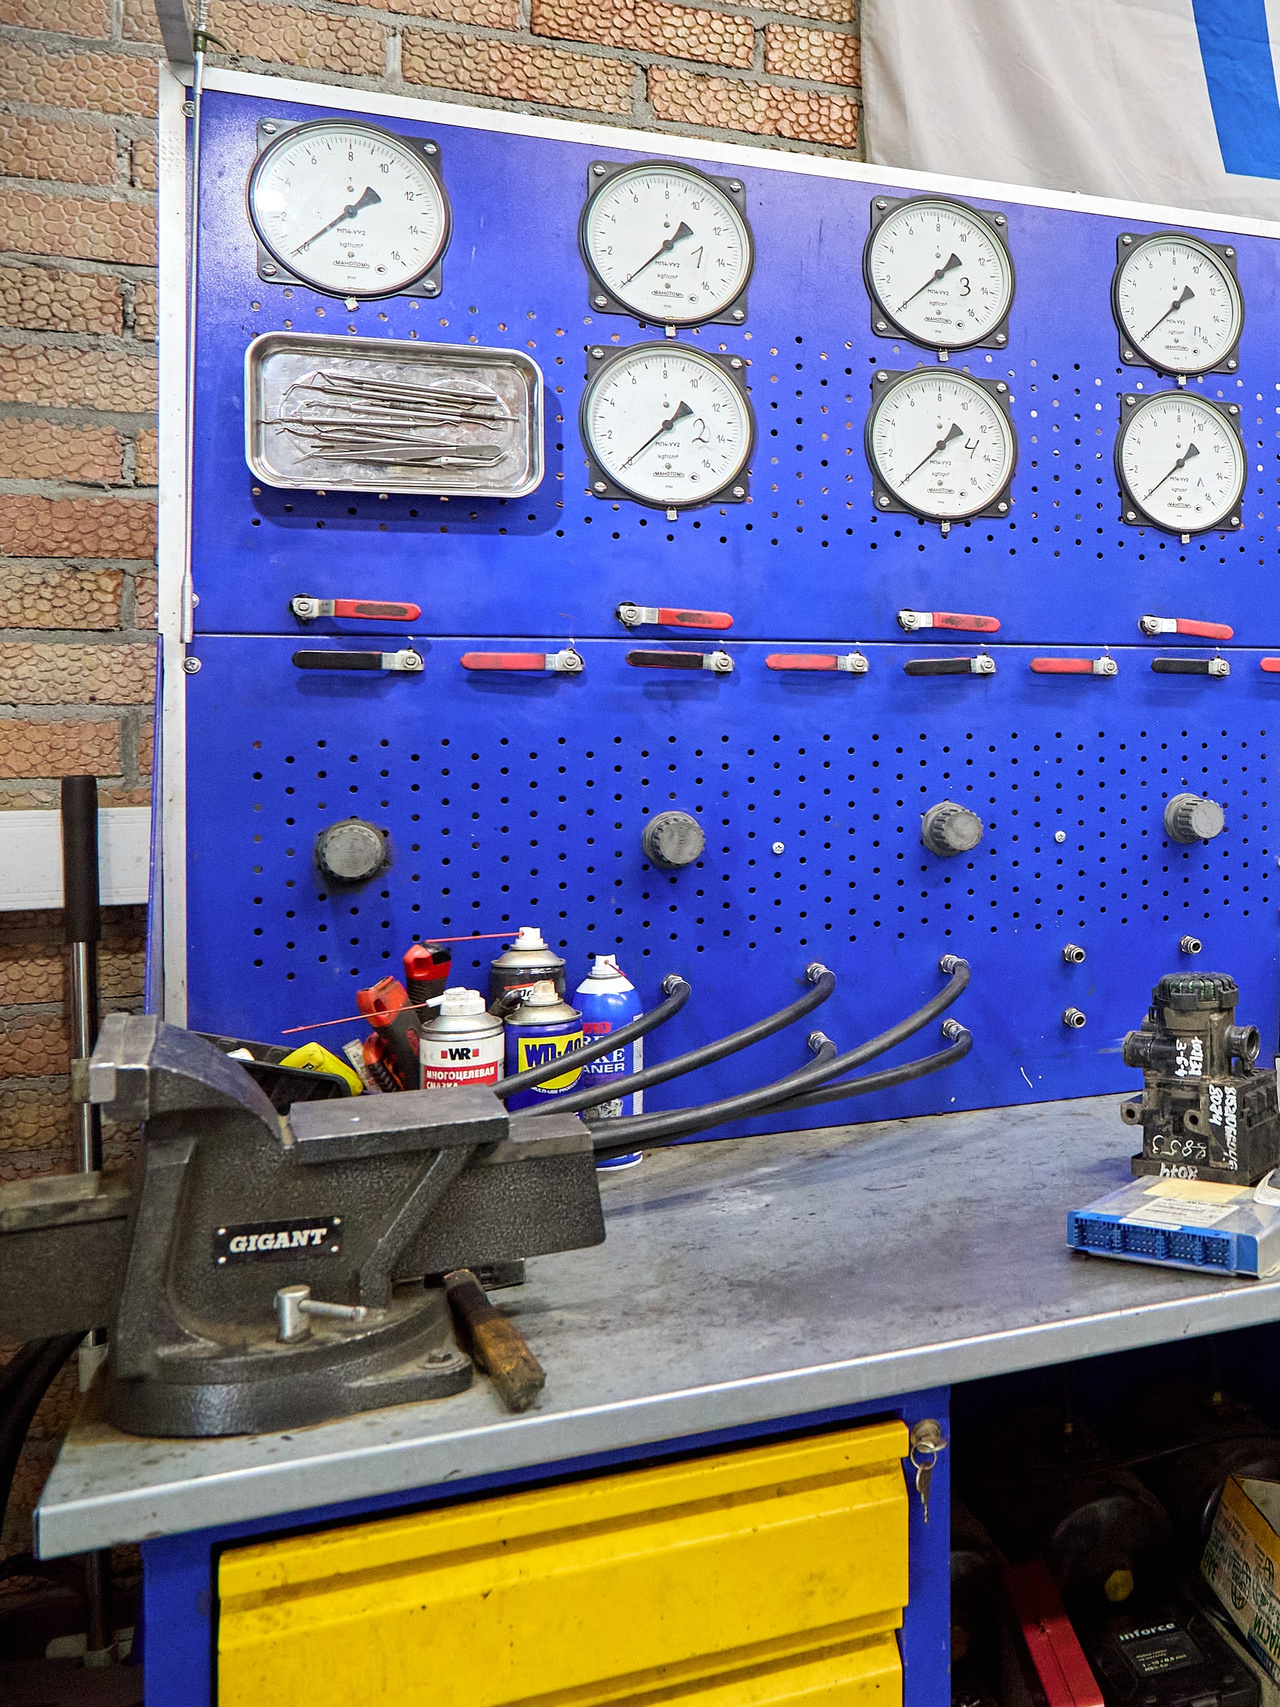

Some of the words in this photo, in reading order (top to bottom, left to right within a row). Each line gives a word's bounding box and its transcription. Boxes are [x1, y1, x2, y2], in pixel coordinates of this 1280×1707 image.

[311, 155, 317, 165] 6
[348, 152, 354, 161] 8
[379, 164, 389, 173] 10
[285, 179, 291, 188] 4
[404, 192, 414, 201] 12
[634, 194, 638, 203] 6
[665, 191, 669, 199] 8
[691, 202, 699, 210] 10
[281, 212, 287, 221] 2
[611, 215, 616, 223] 4
[409, 225, 418, 235] 14
[713, 227, 721, 236] 12
[909, 227, 913, 235] 6
[936, 224, 940, 232] 8
[959, 234, 966, 242] 10
[608, 246, 612, 255] 2
[391, 251, 400, 260] 16
[691, 246, 703, 269] 1
[717, 258, 725, 267] 14
[978, 258, 985, 266] 12
[1193, 266, 1199, 274] 10
[887, 275, 891, 283] 2
[701, 282, 709, 290] 16
[959, 277, 971, 297] 3
[981, 288, 988, 296] 14
[967, 309, 975, 317] 16
[1202, 336, 1208, 344] 16
[663, 370, 668, 379] 8
[632, 377, 636, 385] 6
[690, 379, 698, 388] 10
[937, 394, 942, 402] 8
[610, 399, 615, 407] 4
[910, 399, 915, 407] 6
[961, 402, 968, 410] 10
[712, 403, 720, 412] 12
[891, 419, 896, 427] 4
[1153, 419, 1157, 427] 6
[1177, 415, 1181, 423] 8
[691, 417, 710, 444] 2
[980, 425, 987, 433] 12
[608, 431, 612, 439] 2
[717, 435, 725, 443] 14
[964, 438, 979, 459] 4
[1213, 445, 1220, 453] 12
[889, 449, 893, 457] 2
[983, 454, 991, 462] 14
[702, 460, 710, 468] 16
[1216, 472, 1223, 480] 14
[970, 478, 977, 486] 16
[583, 1022, 611, 1034] BRO
[449, 1047, 471, 1061] WR
[583, 1063, 625, 1074] ANER
[426, 1067, 495, 1081] МНОГОЦЕЛЕВАЯ
[229, 1227, 328, 1254] GIGANT
[1119, 1622, 1176, 1641] inforce
